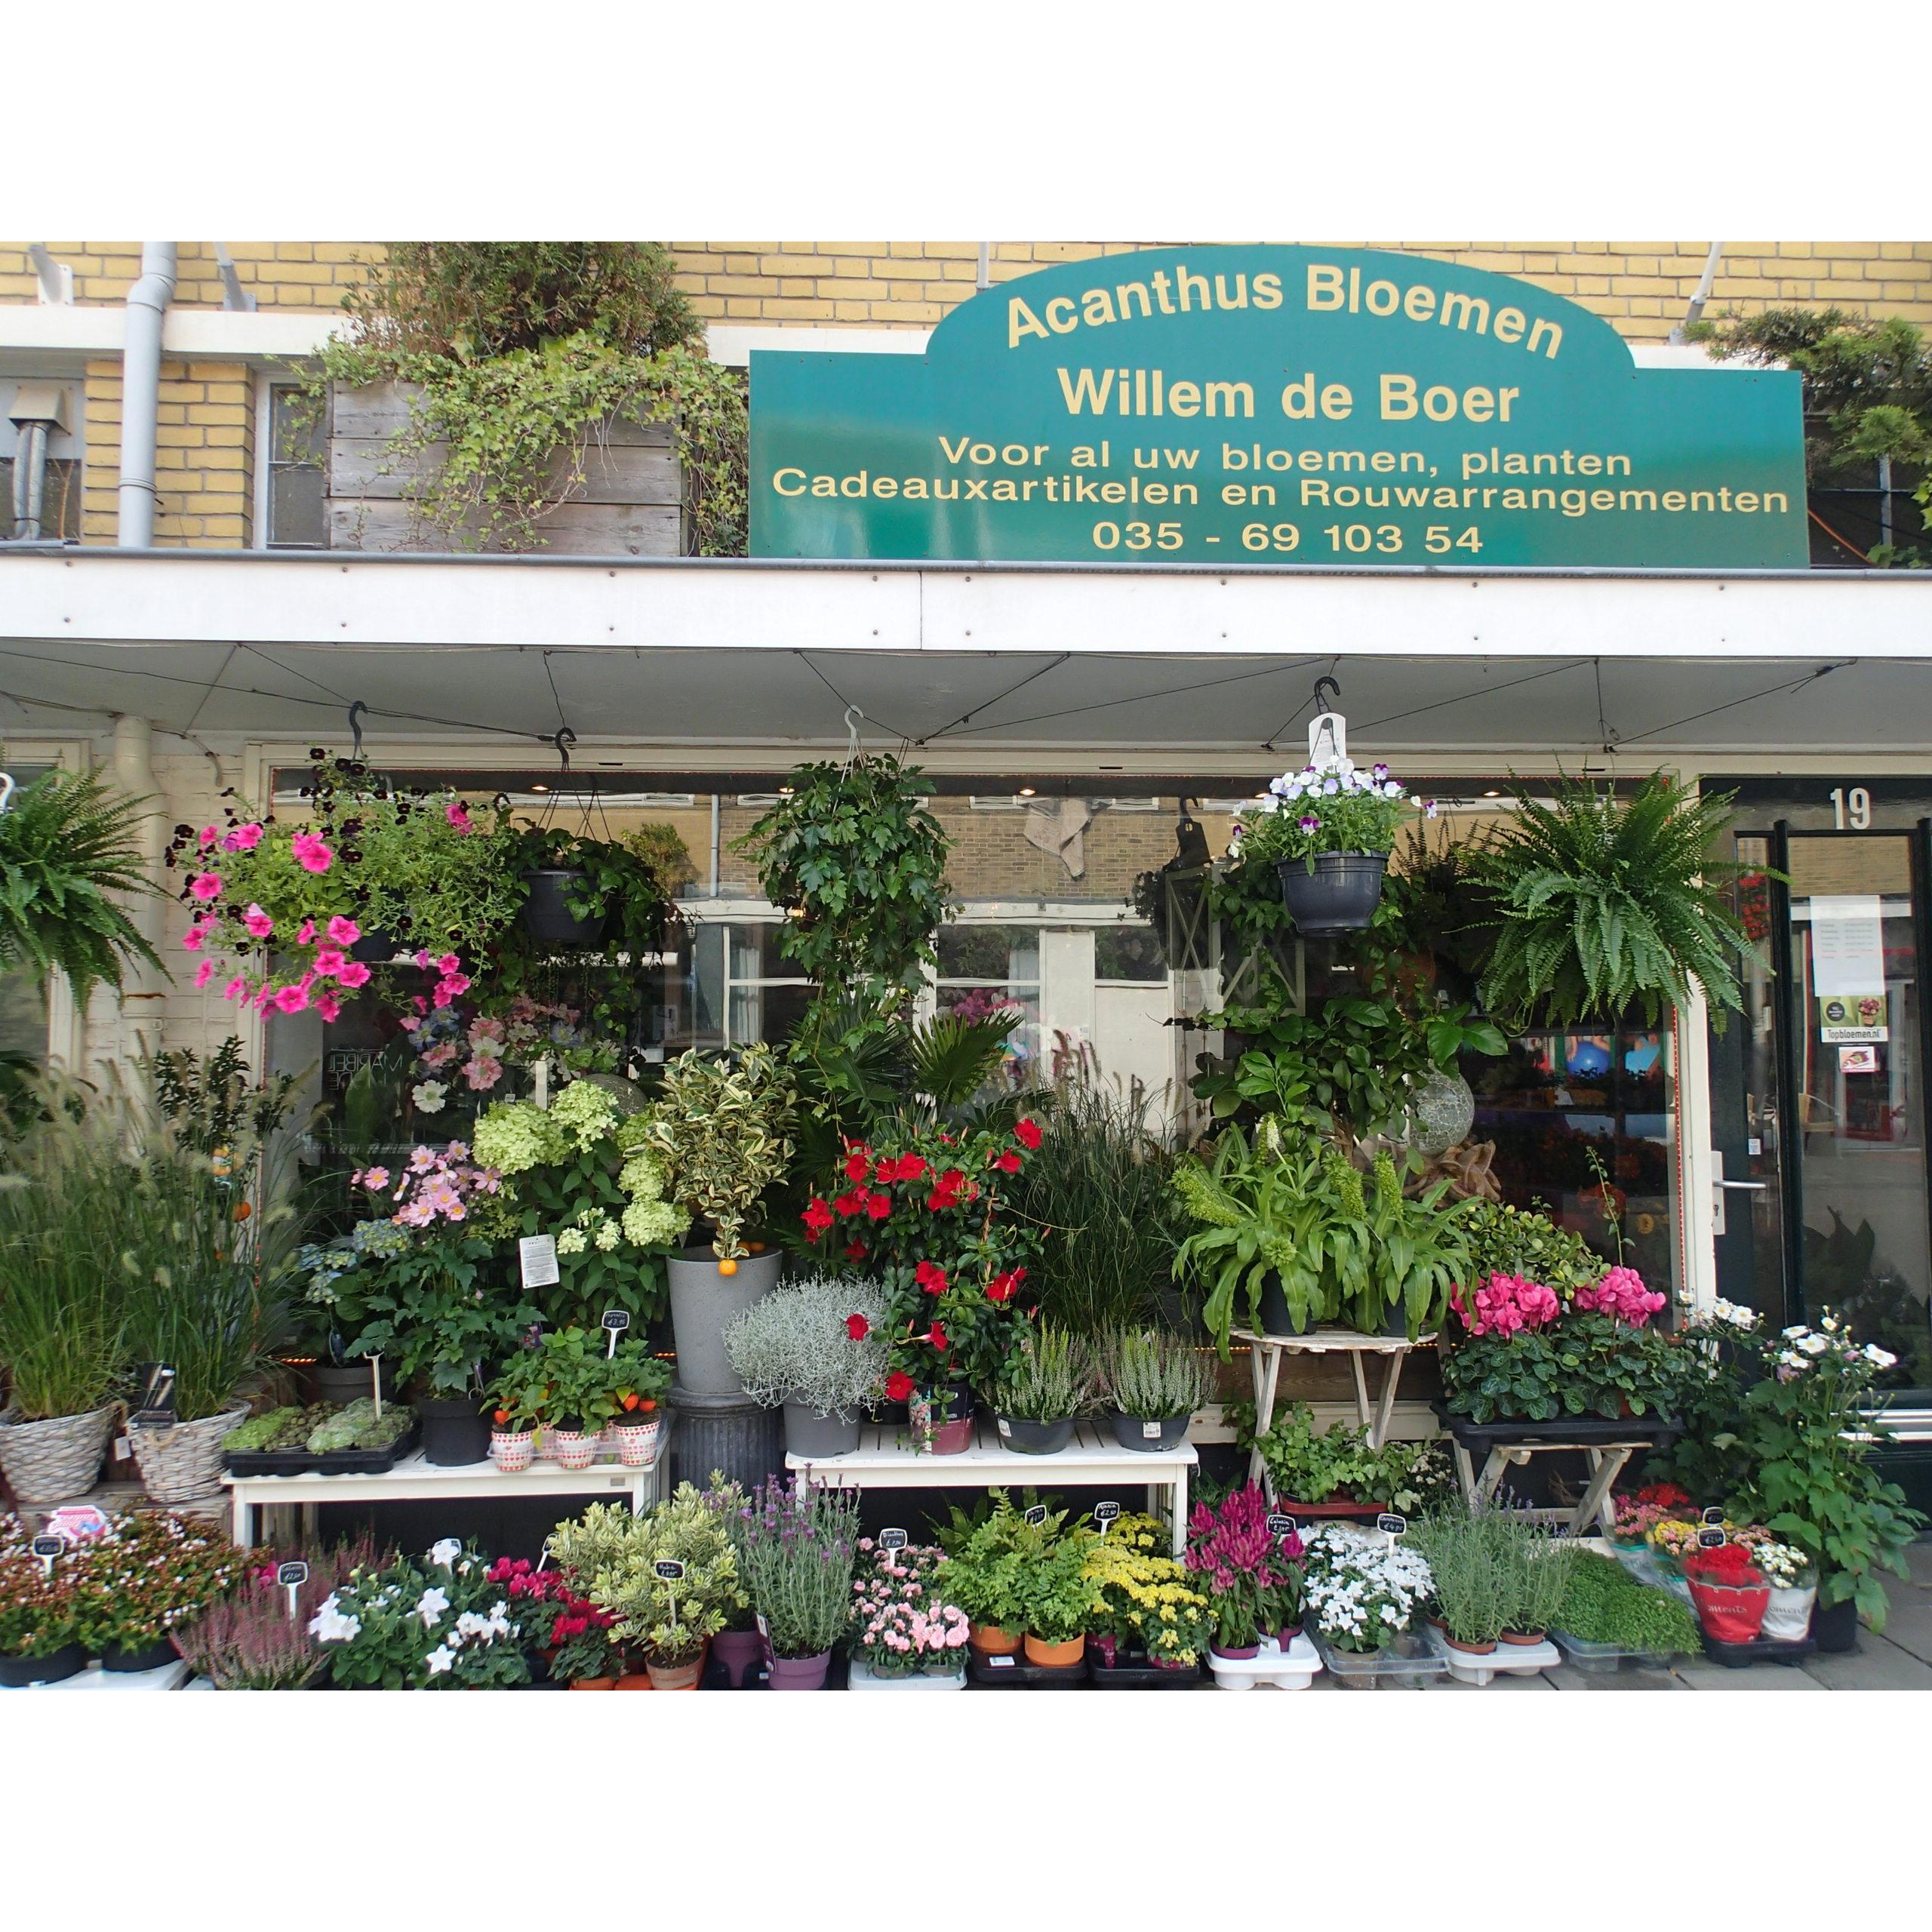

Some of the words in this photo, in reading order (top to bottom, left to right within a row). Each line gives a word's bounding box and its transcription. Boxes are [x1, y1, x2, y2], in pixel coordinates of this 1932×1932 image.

[1010, 266, 1283, 347] Acanthus
[1307, 264, 1562, 358] Bloemen
[1058, 368, 1254, 417] Willem
[1282, 373, 1352, 420] de
[1380, 374, 1519, 422] Boer
[940, 436, 1048, 466] Voor
[1071, 441, 1109, 467] al
[1134, 449, 1199, 469] uw
[1223, 443, 1437, 475] bloemen,
[1463, 448, 1630, 481] planten
[773, 467, 1198, 504] Cadeauxartikelen
[1222, 485, 1275, 506] en
[1301, 479, 1787, 517] Rouwarrangementen
[1093, 521, 1183, 551] 035
[1241, 523, 1300, 551] 69
[1326, 525, 1403, 552] 103
[1425, 526, 1483, 552] 54
[1829, 787, 1871, 830] 19
